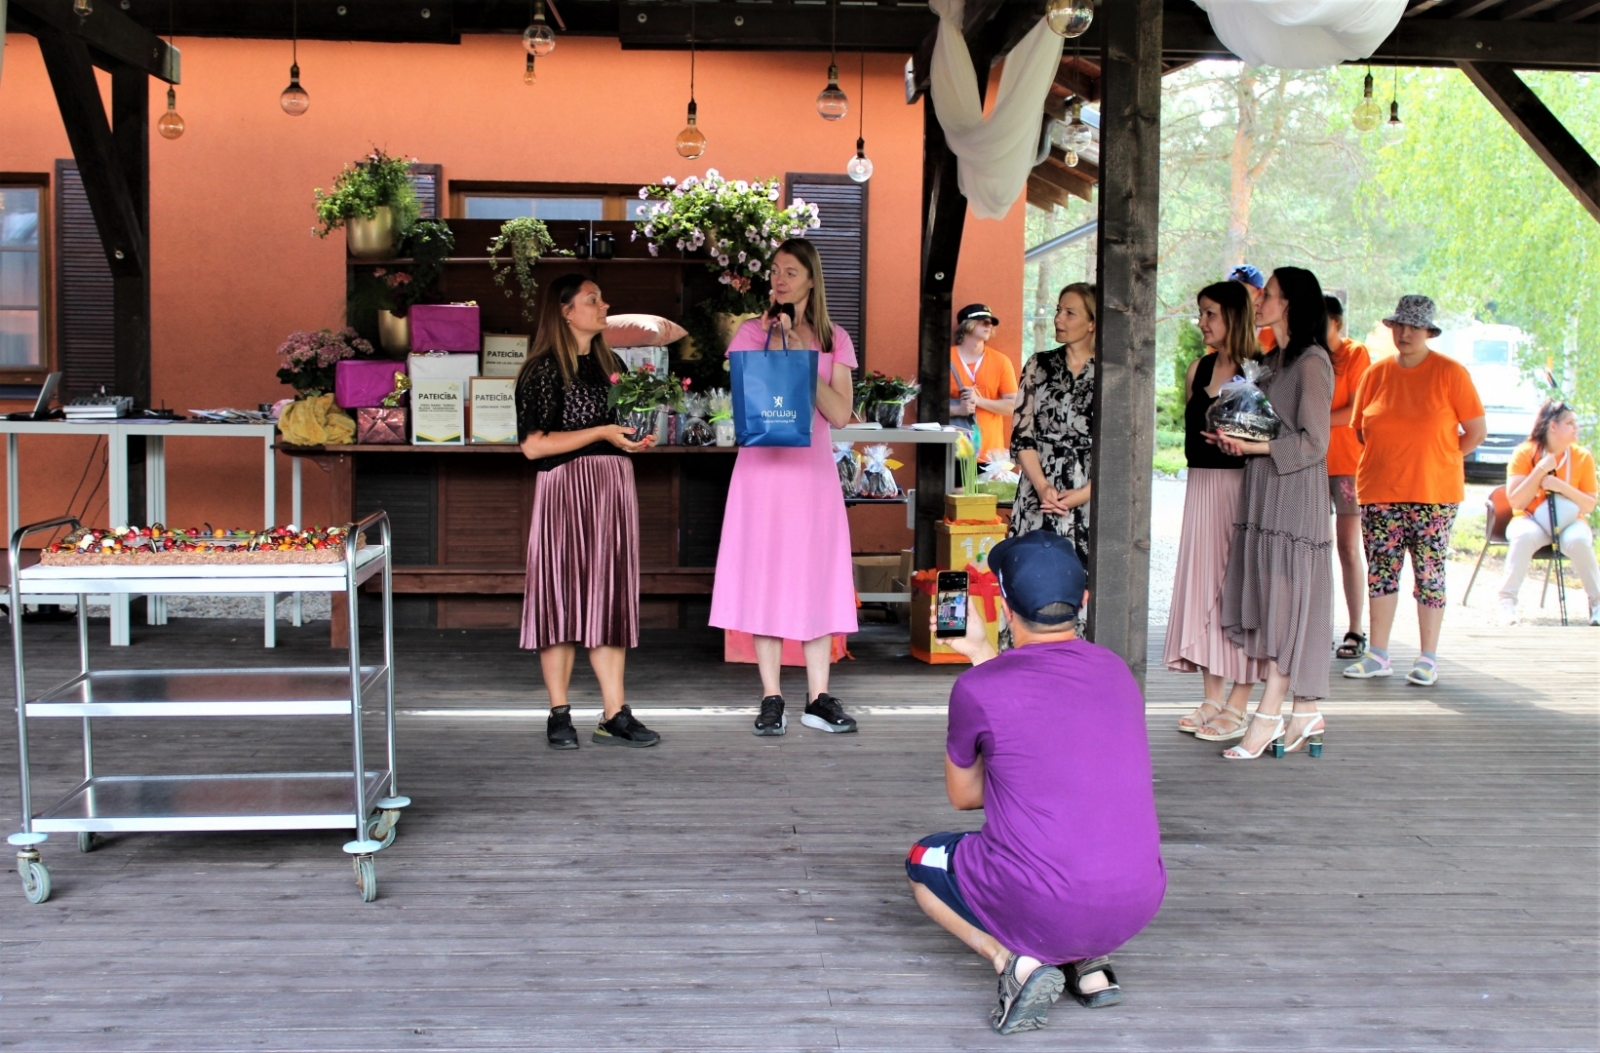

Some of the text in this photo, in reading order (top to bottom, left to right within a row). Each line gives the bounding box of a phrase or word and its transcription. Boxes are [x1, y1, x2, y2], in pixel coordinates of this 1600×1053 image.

[487, 350, 524, 358] PATEICĪBA
[418, 392, 457, 400] PATEICĪBA
[475, 393, 513, 401] PATEICĪBA
[761, 410, 797, 419] norway
